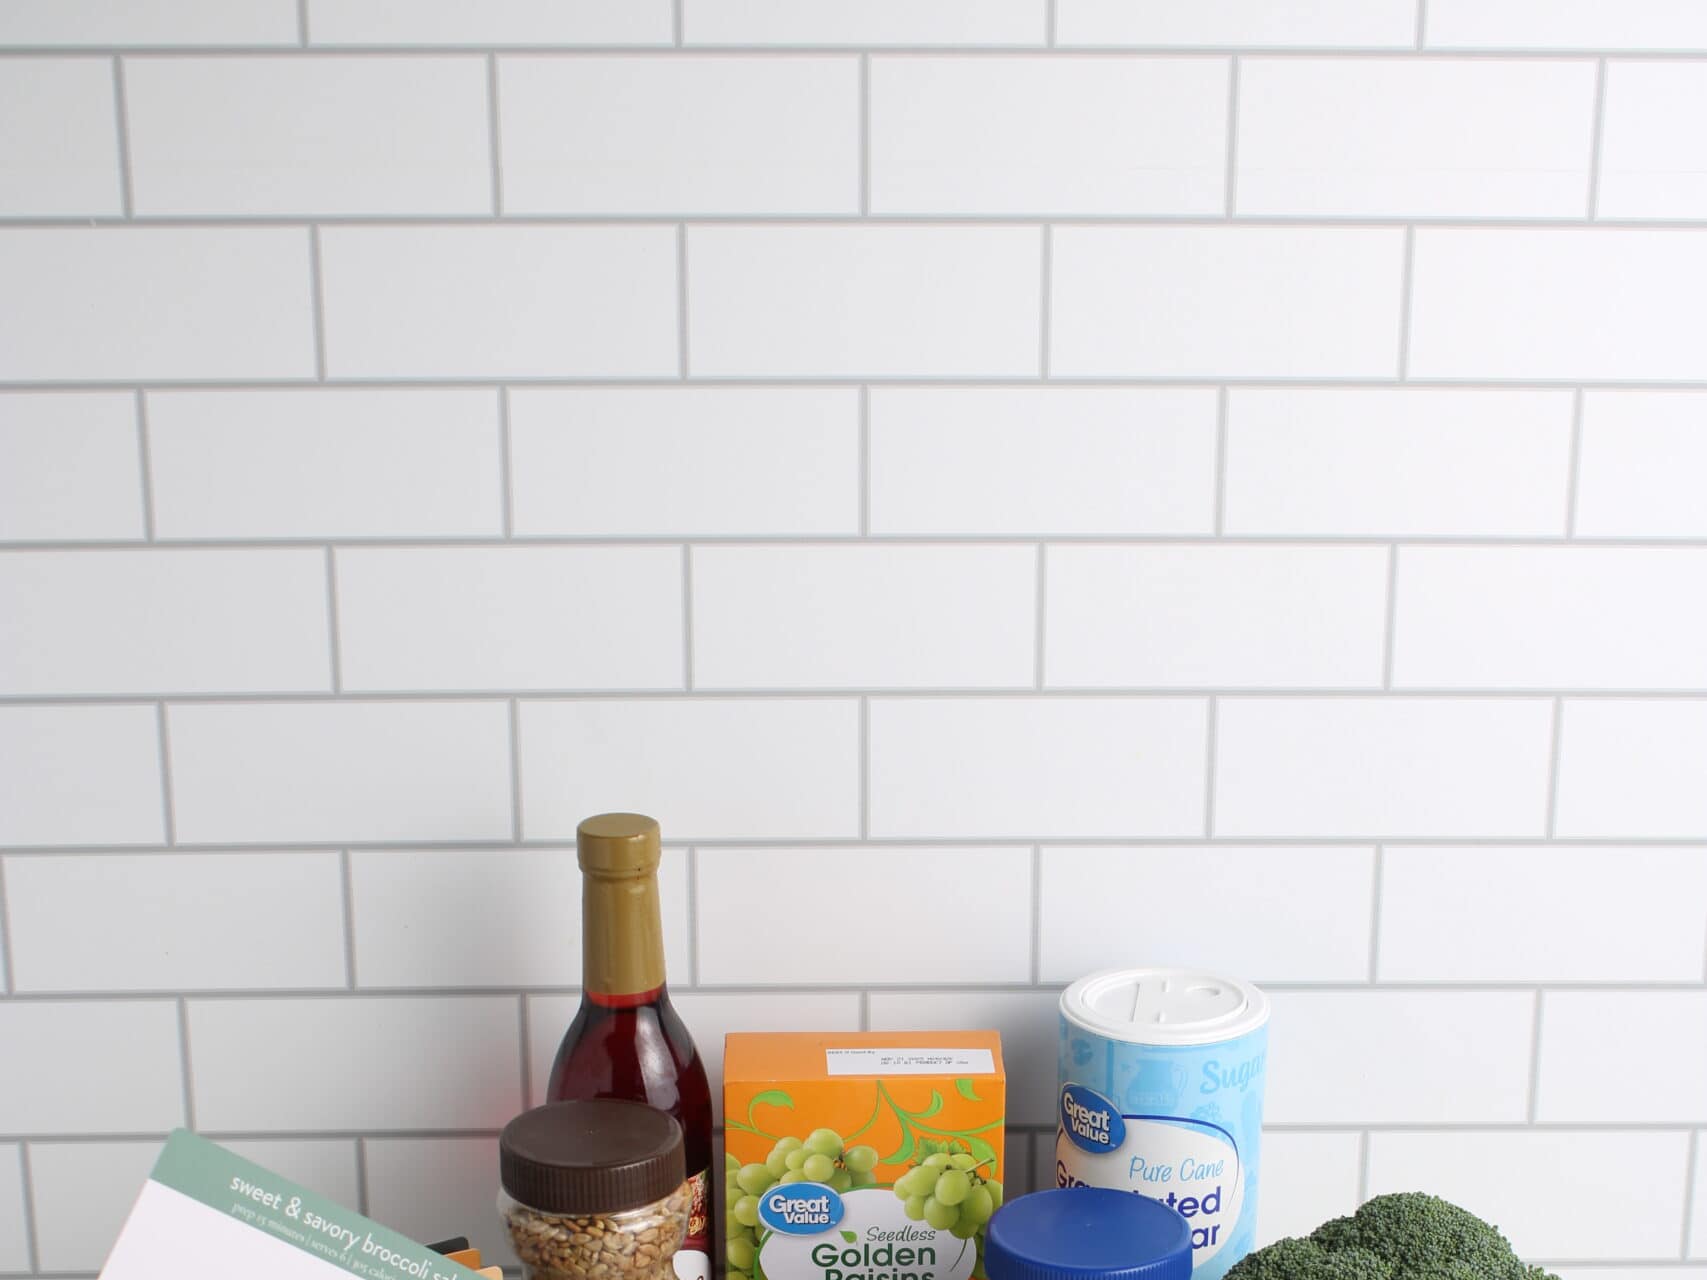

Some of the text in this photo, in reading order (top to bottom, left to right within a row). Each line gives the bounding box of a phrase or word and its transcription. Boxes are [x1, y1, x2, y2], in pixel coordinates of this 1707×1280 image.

[1063, 1092, 1110, 1132] Great
[1071, 1117, 1110, 1145] Value
[1129, 1155, 1224, 1182] Pure Cane
[769, 1194, 830, 1213] Great
[229, 1177, 282, 1211] sweet
[285, 1196, 301, 1219] &
[303, 1212, 361, 1251] savory
[361, 1232, 432, 1279] broccoli
[784, 1211, 830, 1225] Value
[866, 1225, 937, 1243] Seedless
[811, 1243, 936, 1267] Golden
